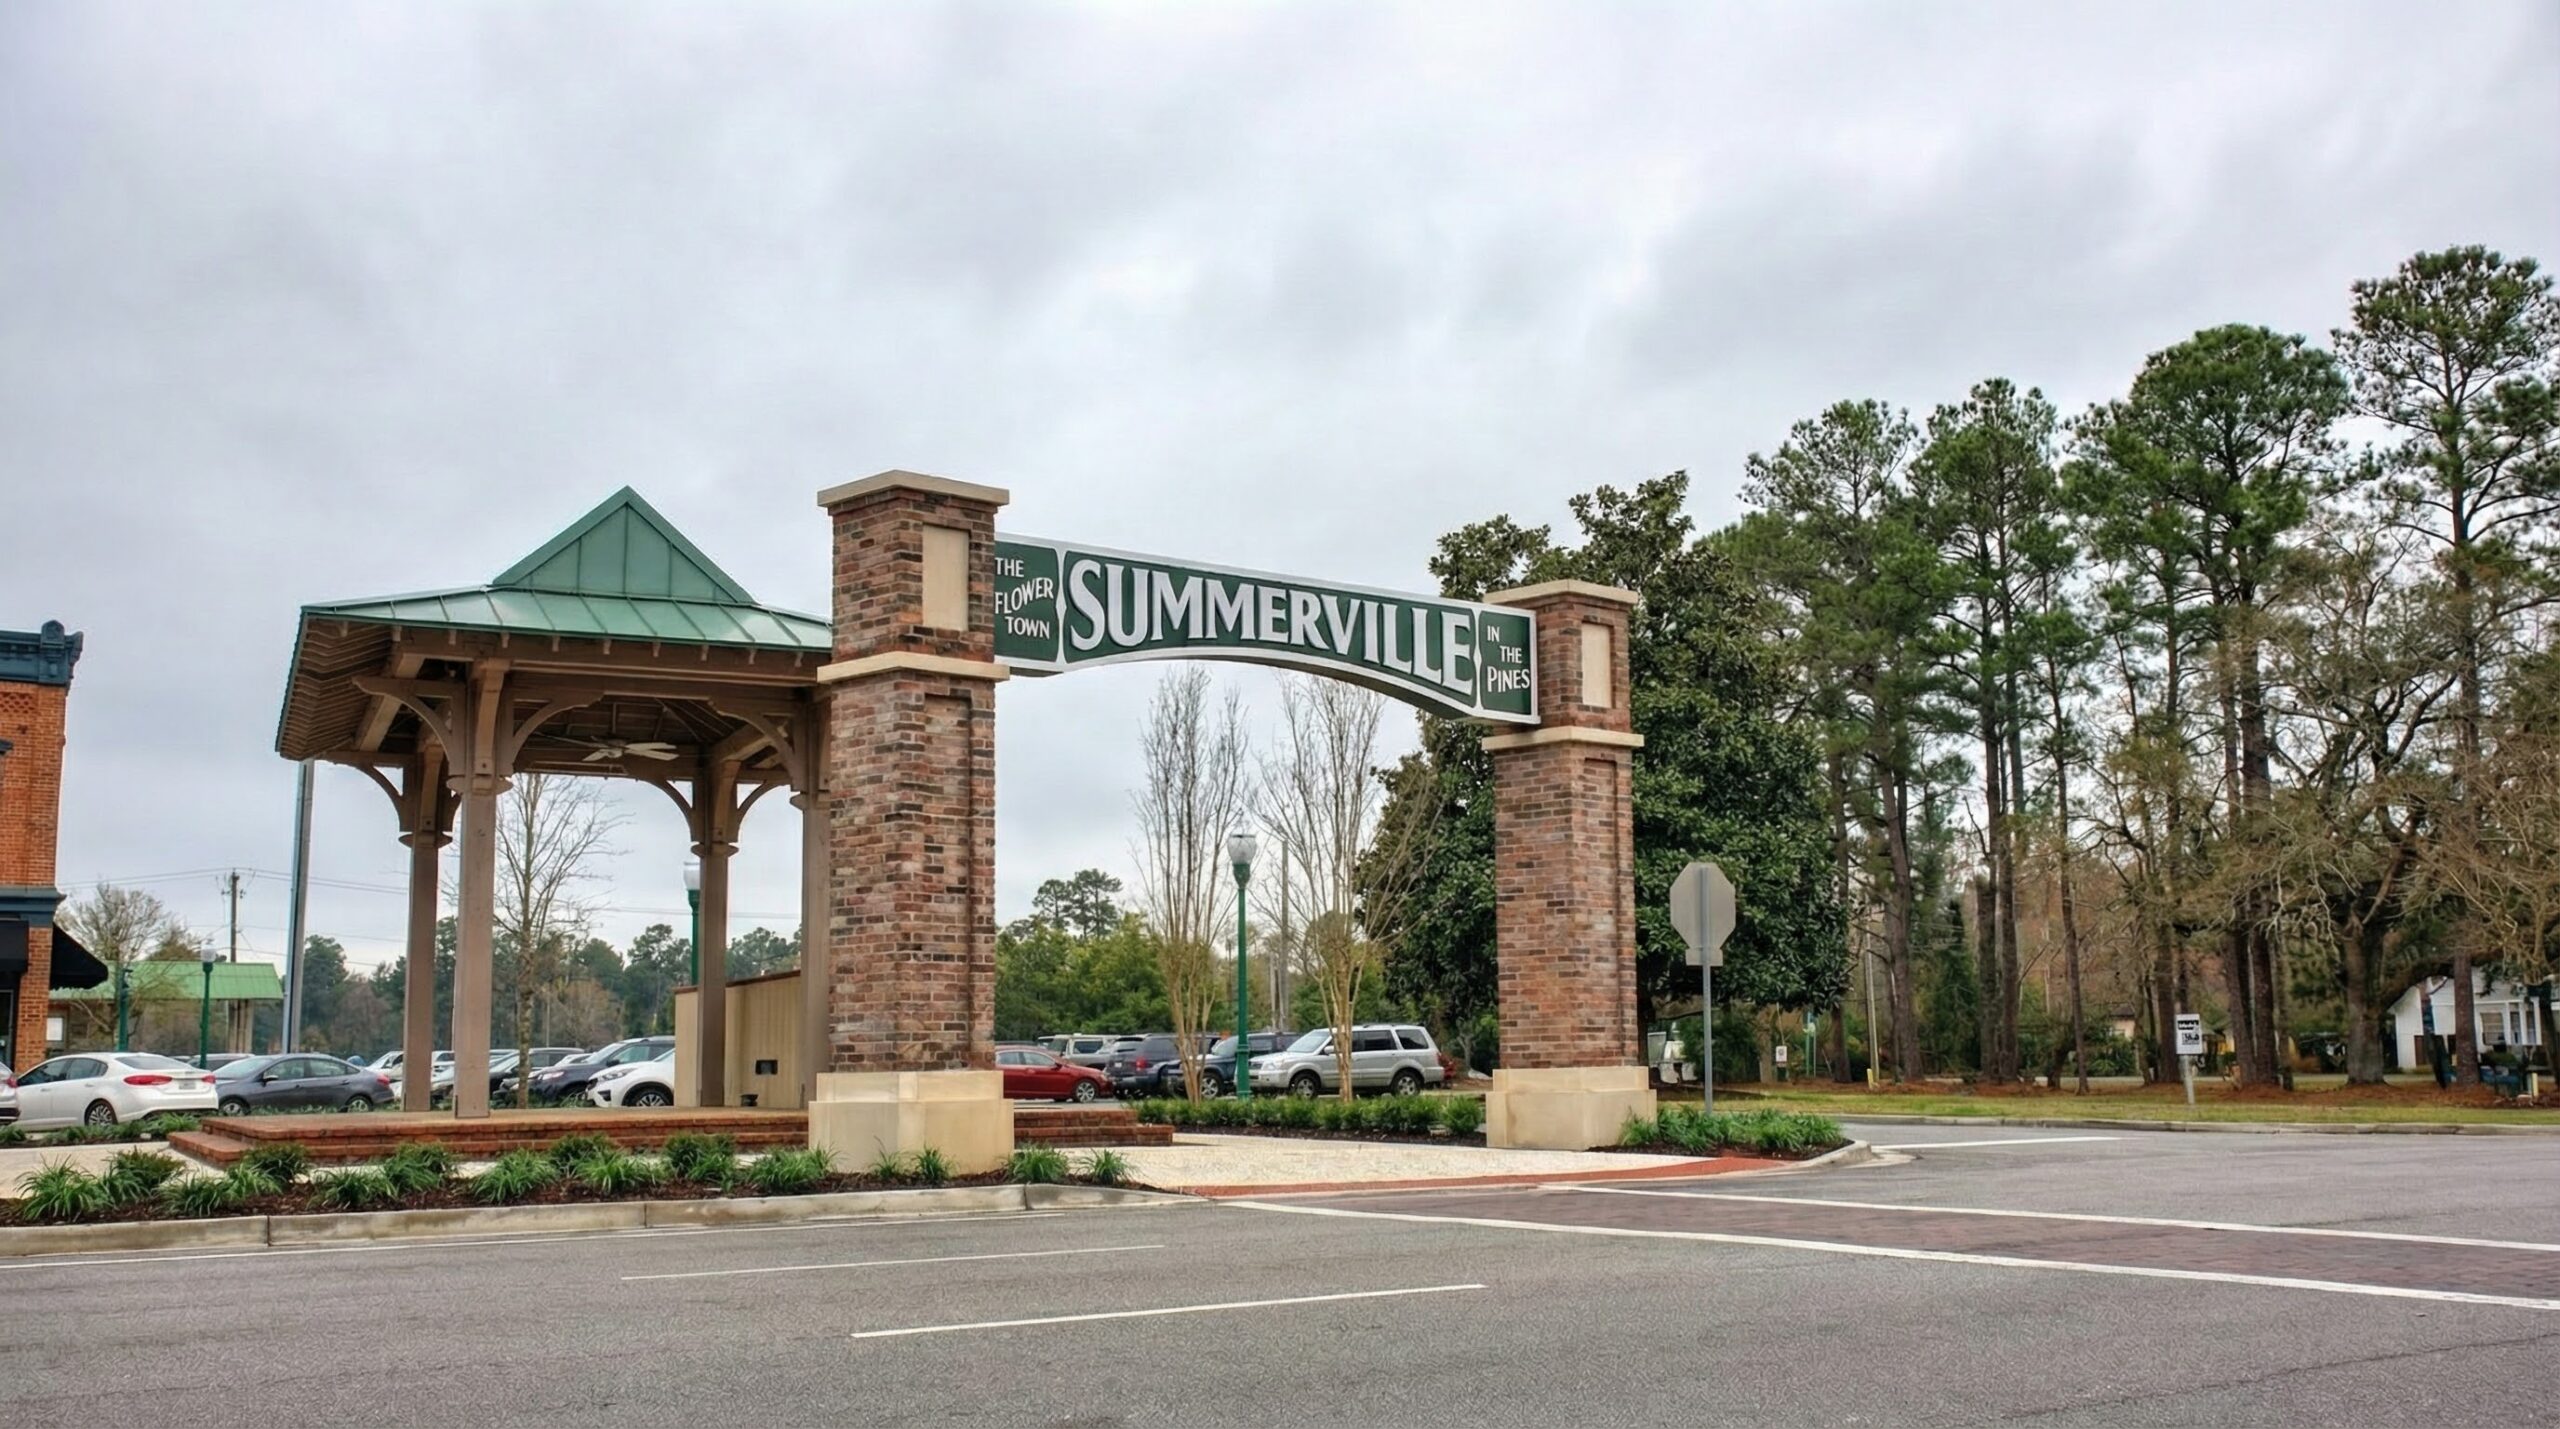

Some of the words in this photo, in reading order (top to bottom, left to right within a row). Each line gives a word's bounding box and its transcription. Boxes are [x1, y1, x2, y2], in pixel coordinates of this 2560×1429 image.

[995, 557, 1025, 578] THE
[995, 577, 1054, 615] FLOWER
[1004, 616, 1050, 640] TOWN
[1069, 558, 1474, 696] SUMMERVILLE
[1487, 625, 1500, 642] IN
[1499, 645, 1523, 664] THE
[1487, 665, 1530, 693] PINES
